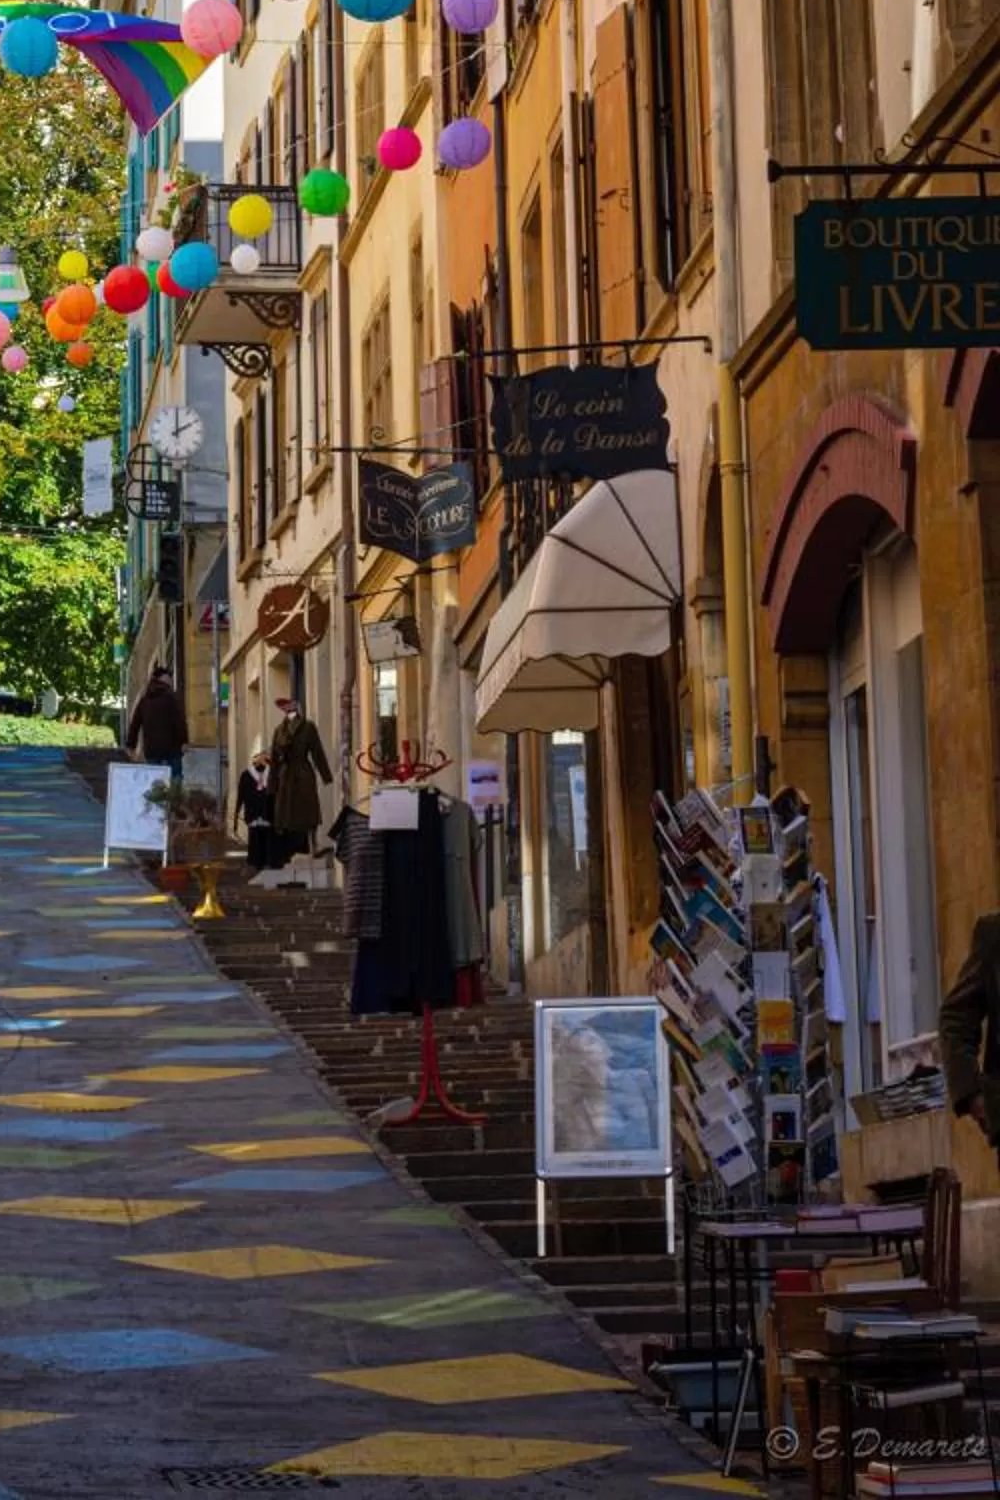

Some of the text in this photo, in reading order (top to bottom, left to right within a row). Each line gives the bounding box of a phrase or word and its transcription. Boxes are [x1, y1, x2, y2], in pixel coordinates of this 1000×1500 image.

[892, 250, 943, 280] DU
[839, 282, 1000, 333] LIVRE
[533, 390, 624, 419] Le coin
[502, 422, 659, 457] de la Danse
